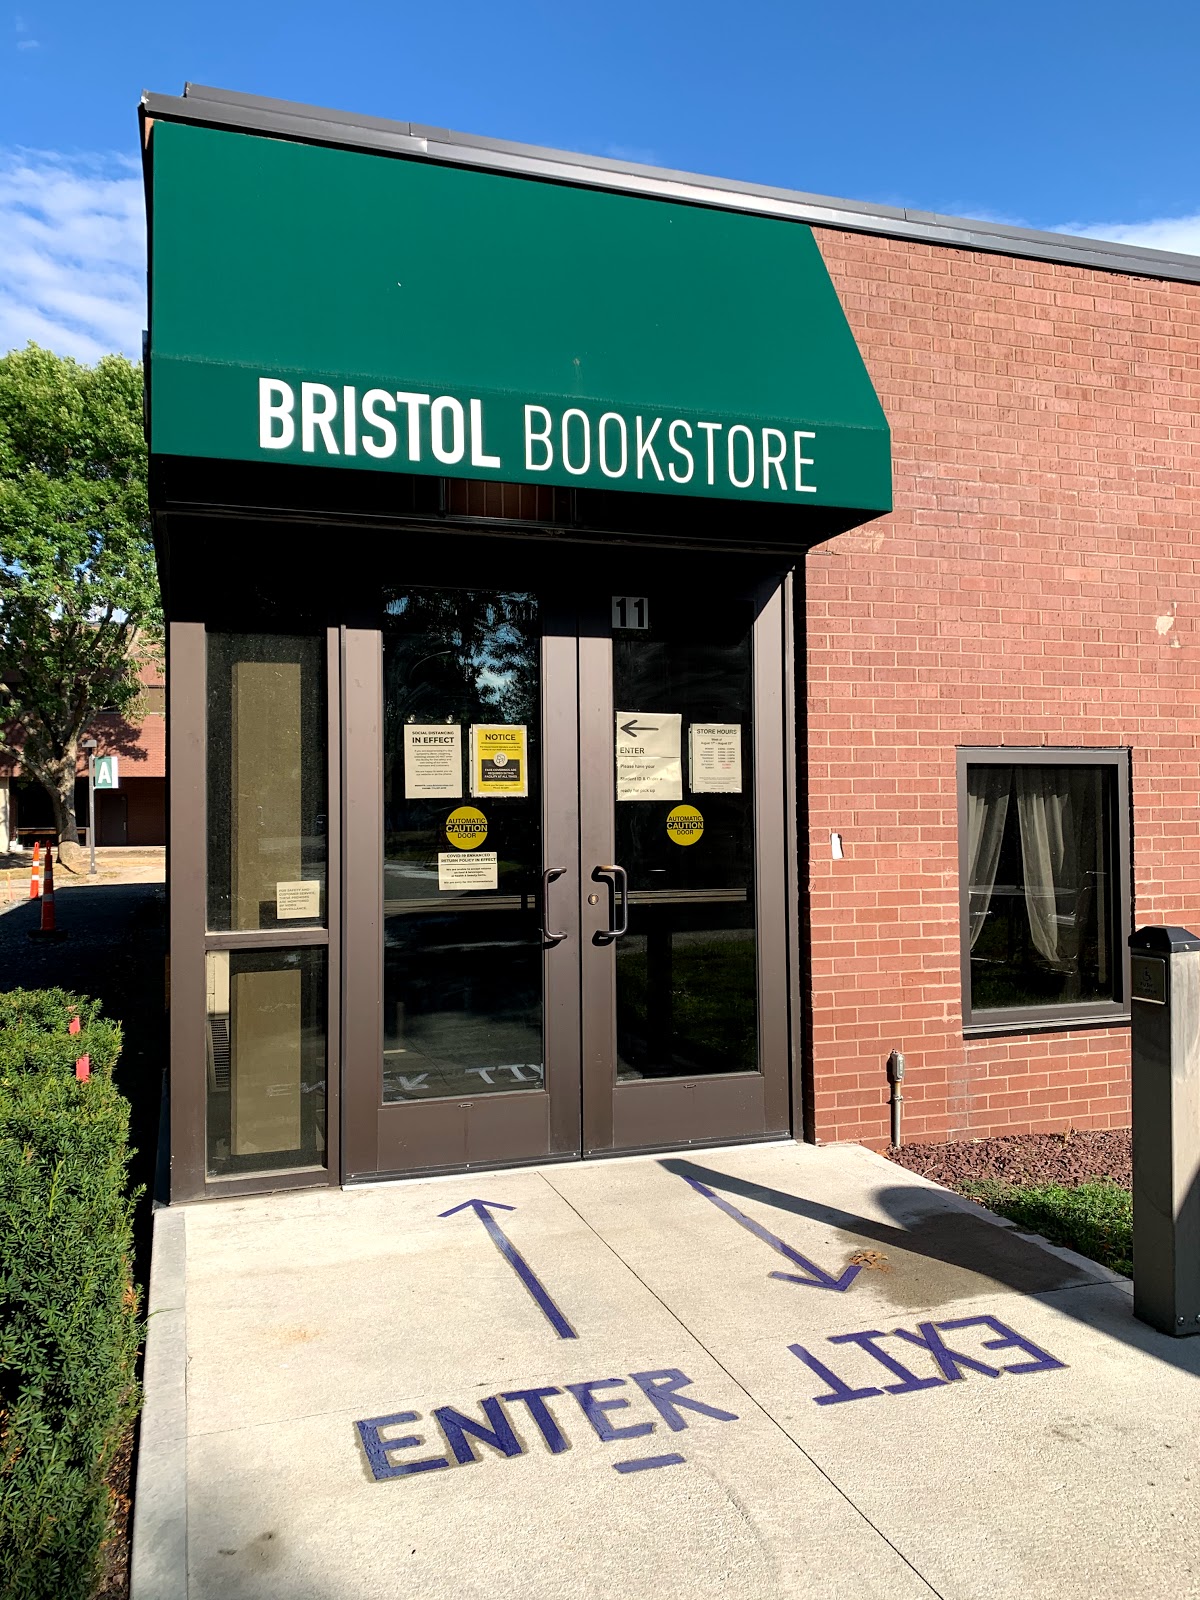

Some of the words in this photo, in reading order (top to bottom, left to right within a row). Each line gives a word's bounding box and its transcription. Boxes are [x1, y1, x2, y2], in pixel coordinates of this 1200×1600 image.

[258, 377, 501, 469] BRISTOL
[524, 404, 818, 493] BOOKSTORE
[615, 597, 645, 628] 11
[485, 733, 516, 741] NOTICE
[97, 761, 112, 784] A
[446, 824, 488, 832] CAUTION
[666, 821, 704, 830] CAUTION
[786, 1315, 1069, 1405] EXIT
[354, 1368, 739, 1481] ENTER
